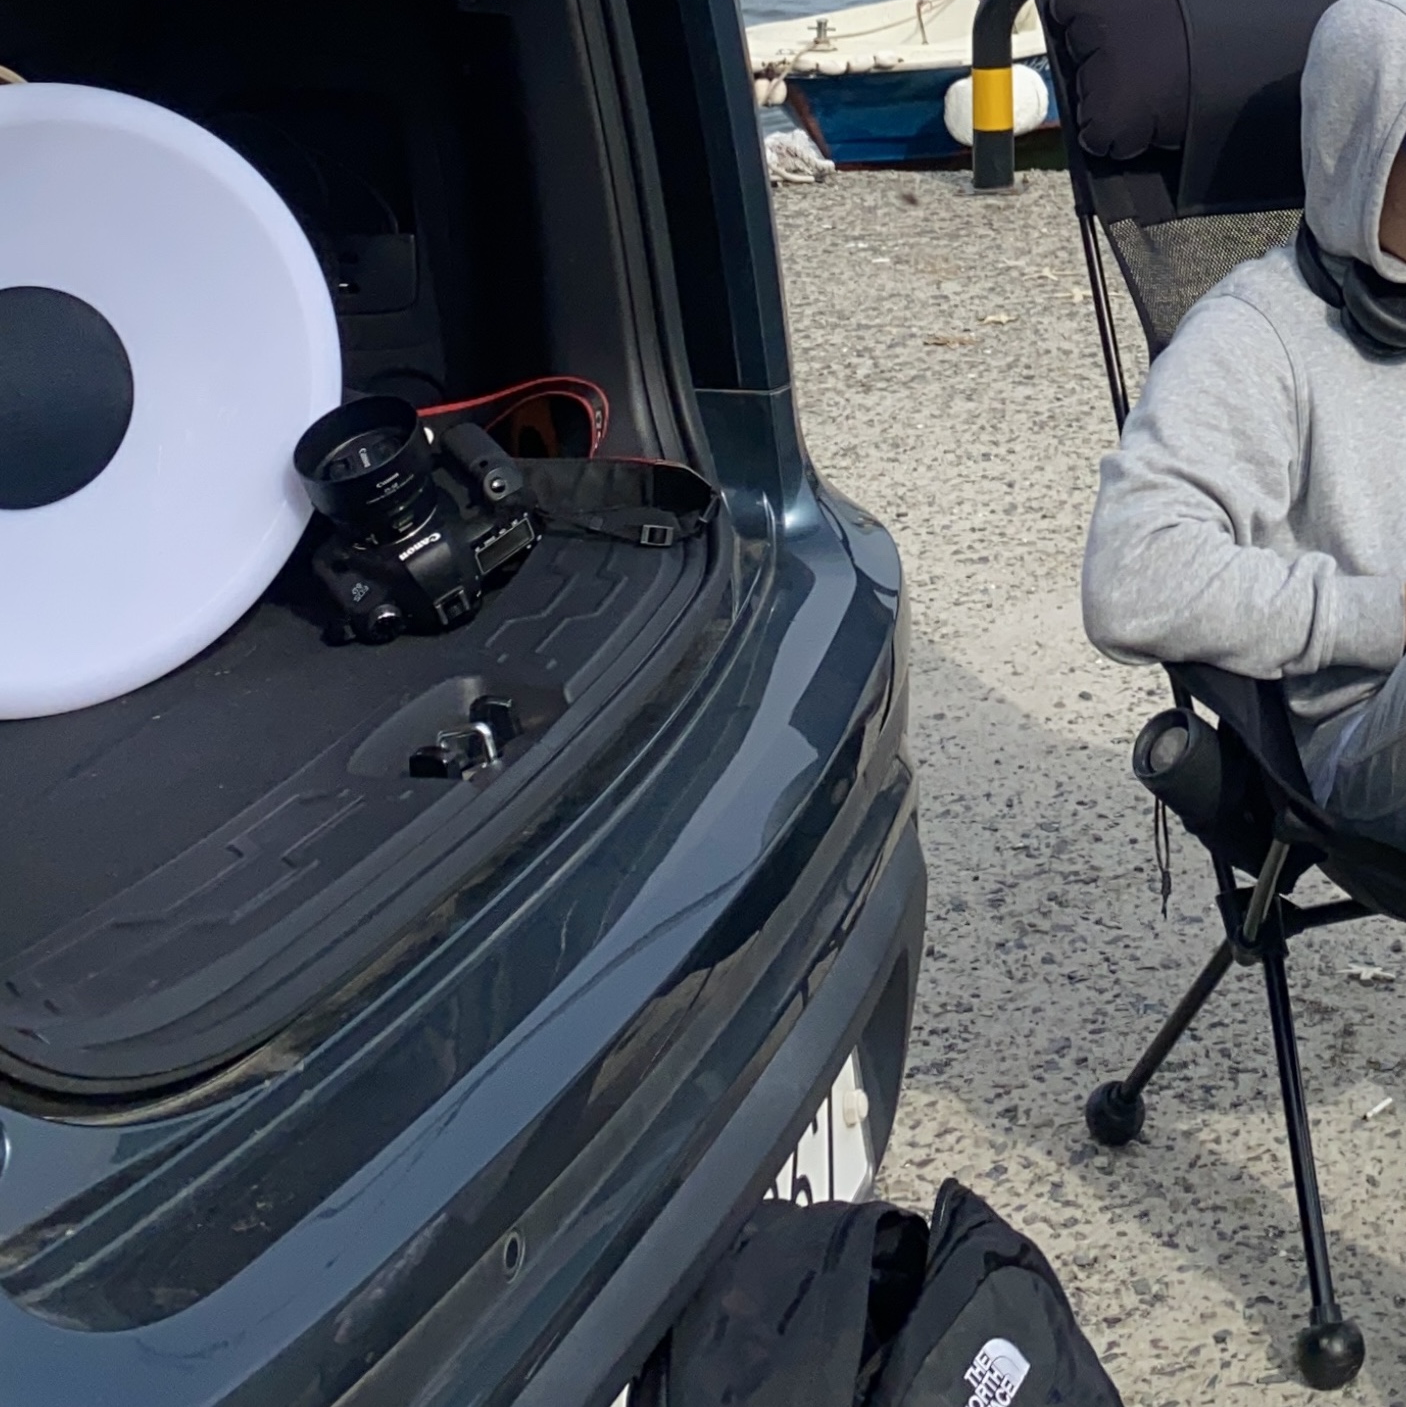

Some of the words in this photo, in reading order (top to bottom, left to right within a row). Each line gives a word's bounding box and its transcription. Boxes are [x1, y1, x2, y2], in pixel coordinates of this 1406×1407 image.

[399, 533, 441, 561] Canon
[963, 1350, 992, 1388] THE
[965, 1364, 1003, 1407] ORTH
[987, 1373, 1016, 1407] CE
